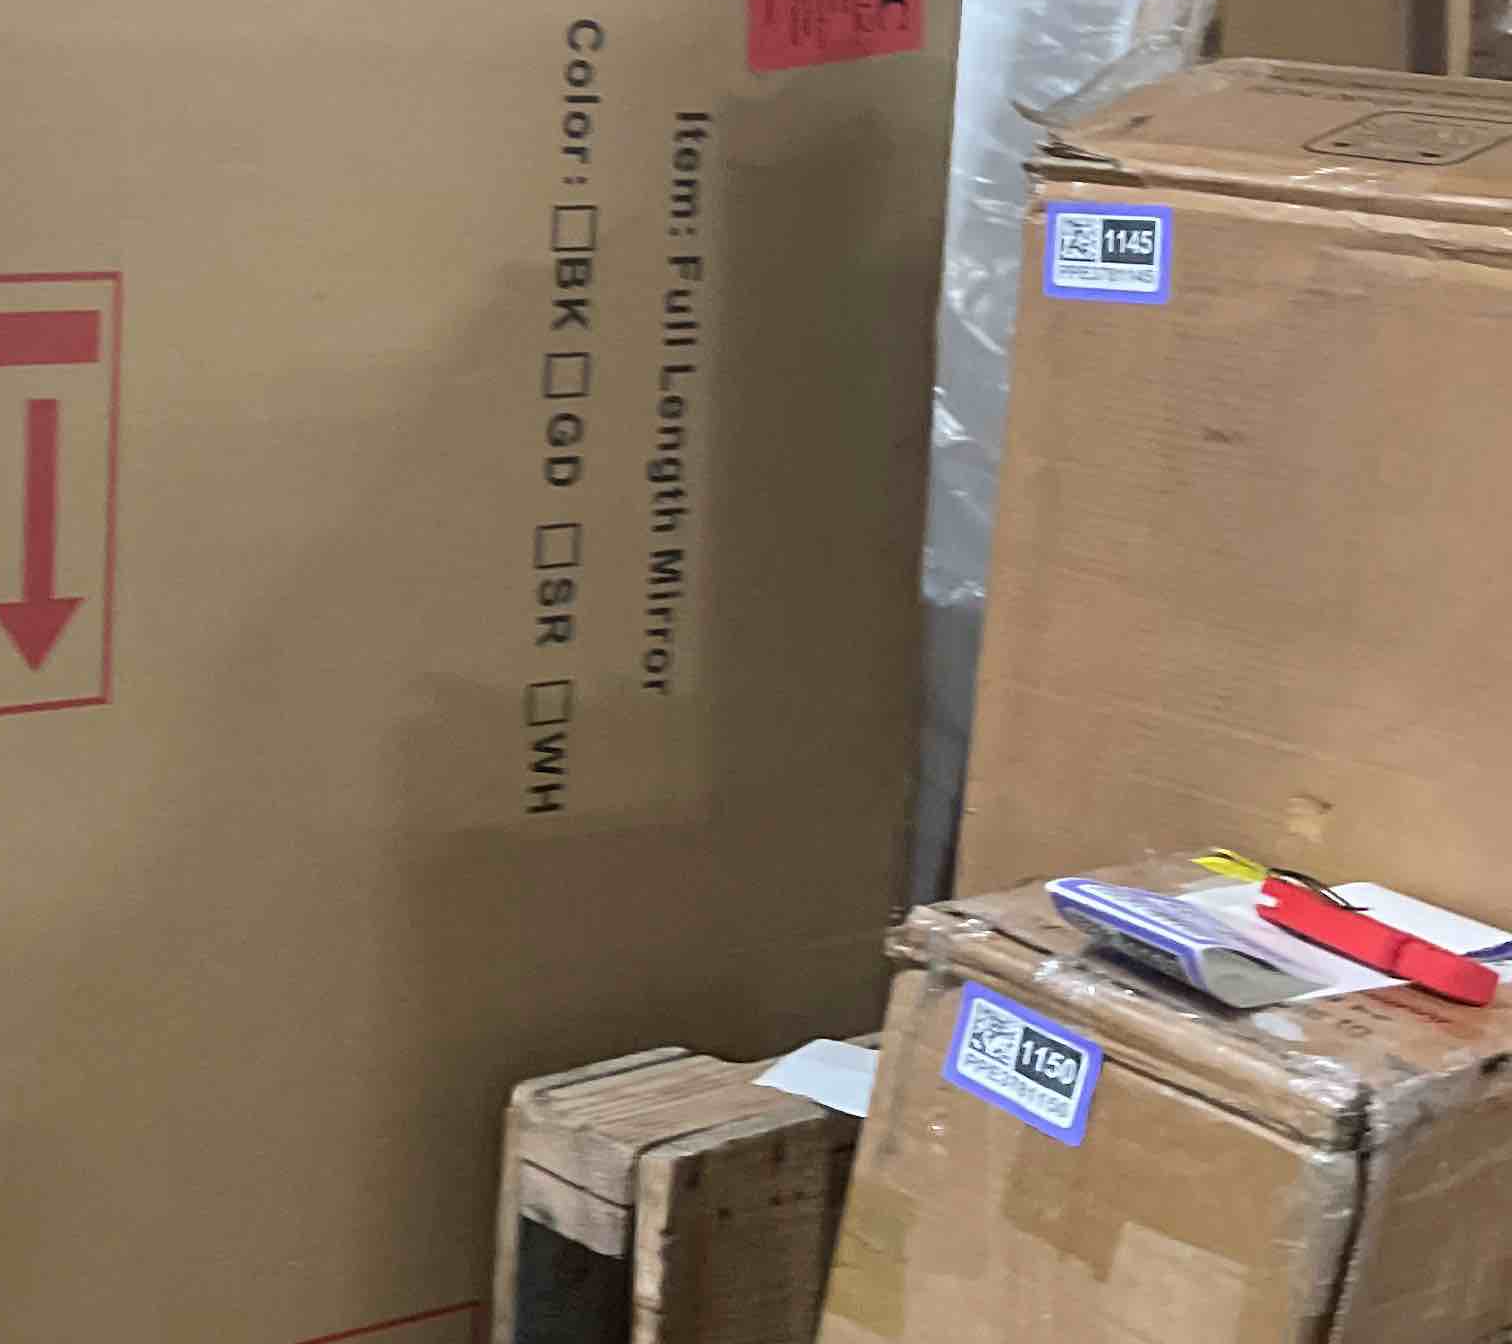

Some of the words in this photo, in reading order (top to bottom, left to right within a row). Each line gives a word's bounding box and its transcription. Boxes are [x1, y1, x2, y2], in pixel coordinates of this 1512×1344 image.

[560, 18, 605, 186] Color:
[668, 111, 712, 236] Item:
[1104, 228, 1155, 256] 1145
[550, 257, 593, 330] BK
[660, 255, 704, 346] Full
[543, 412, 585, 488] GD
[645, 364, 697, 534] Length
[533, 578, 577, 647] SR
[640, 548, 687, 696] Mirror
[524, 730, 569, 816] WH
[1020, 1039, 1078, 1086] 1150
